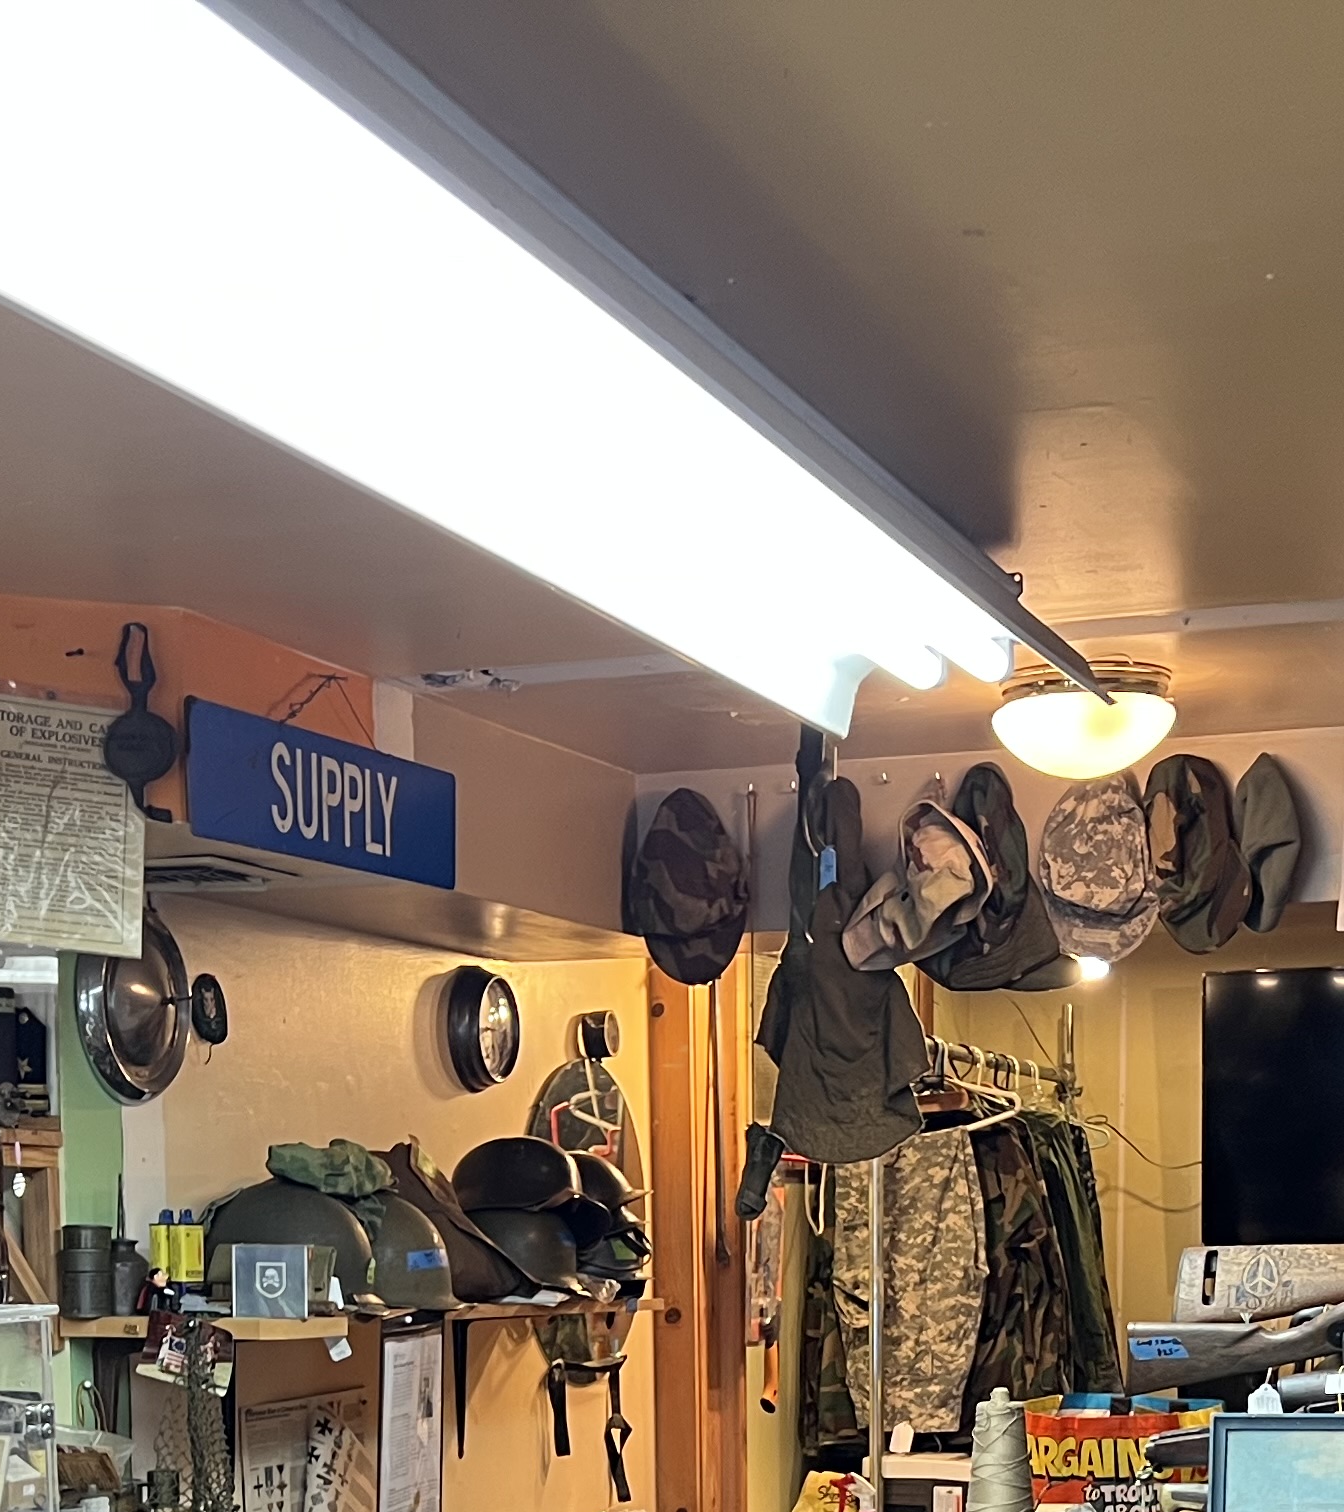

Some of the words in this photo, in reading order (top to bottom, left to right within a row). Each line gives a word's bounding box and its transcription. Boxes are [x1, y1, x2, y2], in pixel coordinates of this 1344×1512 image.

[9, 724, 27, 738] OF
[31, 728, 105, 748] EXPLOSIVES
[56, 718, 83, 731] AND
[88, 722, 109, 734] CA
[0, 750, 43, 763] GENERAL
[48, 755, 108, 770] INSTRUCTION
[270, 741, 398, 857] SUPPLY
[1027, 1434, 1173, 1481] ARGAIN
[1083, 1484, 1101, 1502] to
[1101, 1483, 1161, 1503] TROUT
